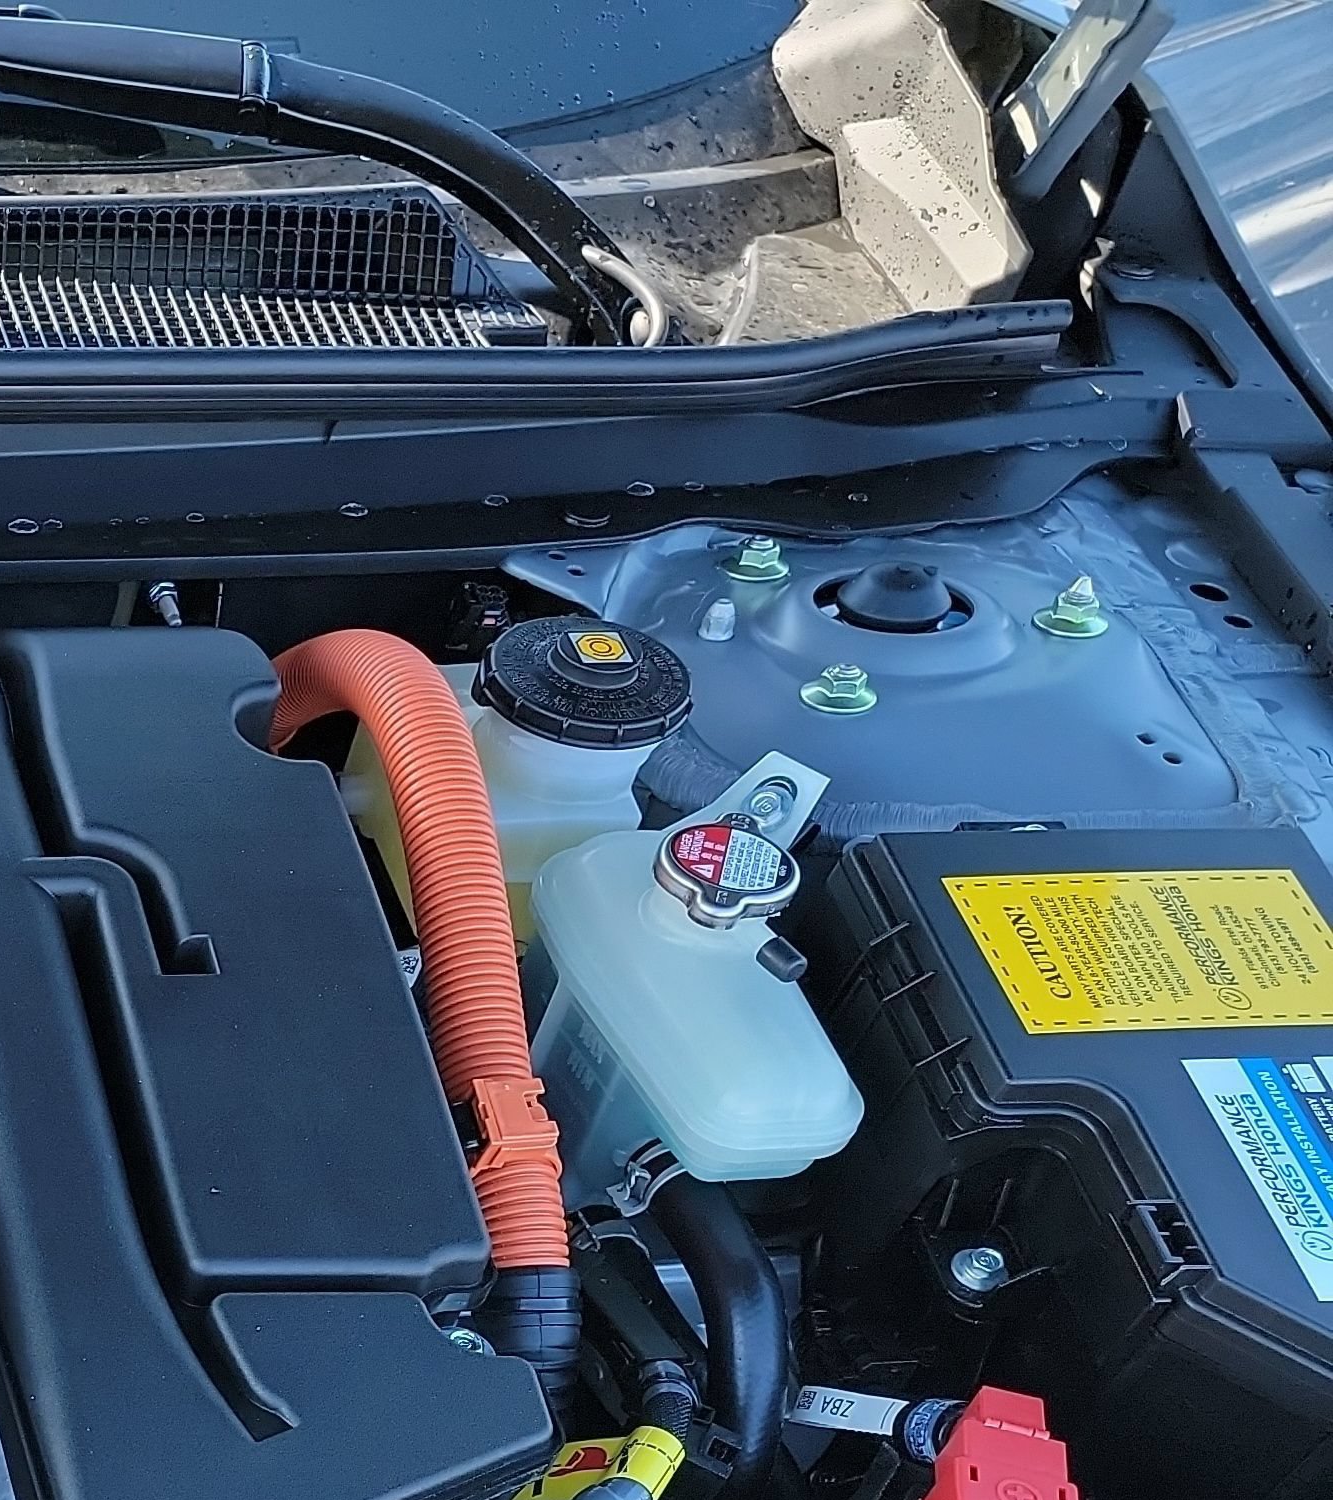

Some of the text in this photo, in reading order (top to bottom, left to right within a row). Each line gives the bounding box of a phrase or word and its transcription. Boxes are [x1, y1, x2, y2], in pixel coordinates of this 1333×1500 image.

[672, 831, 698, 861] DANGER
[1043, 897, 1064, 916] MILE
[1056, 896, 1076, 914] THIS
[1103, 905, 1132, 940] SPECIAL
[1166, 885, 1239, 985] KINGS Honda
[1001, 905, 1075, 998] CAUTION!
[1028, 895, 1103, 1008] MANY PARTS ARE COVERED
[1068, 894, 1145, 1006] VEHICLE IS EQUIPPED WITH
[1083, 897, 1155, 1001] AN ON BOARD HIGH TECH
[1109, 894, 1184, 1003] TRAINING AND TOOLS ARE
[1147, 885, 1223, 986] PERFORMANCE
[1150, 938, 1166, 951] TO
[1238, 930, 1254, 943] OH
[1254, 906, 1312, 984] 24 HOUR TOWING
[1091, 978, 1108, 992] AN
[1097, 965, 1130, 1005] FACTORY
[1099, 993, 1115, 1004] BY
[1158, 952, 1193, 995] REQUIRED
[1256, 1071, 1323, 1163] INSTALLATION
[1214, 1093, 1307, 1228] PERFORMANCE
[1237, 1093, 1329, 1227] KINGS Honda
[820, 1396, 854, 1417] ZBA
